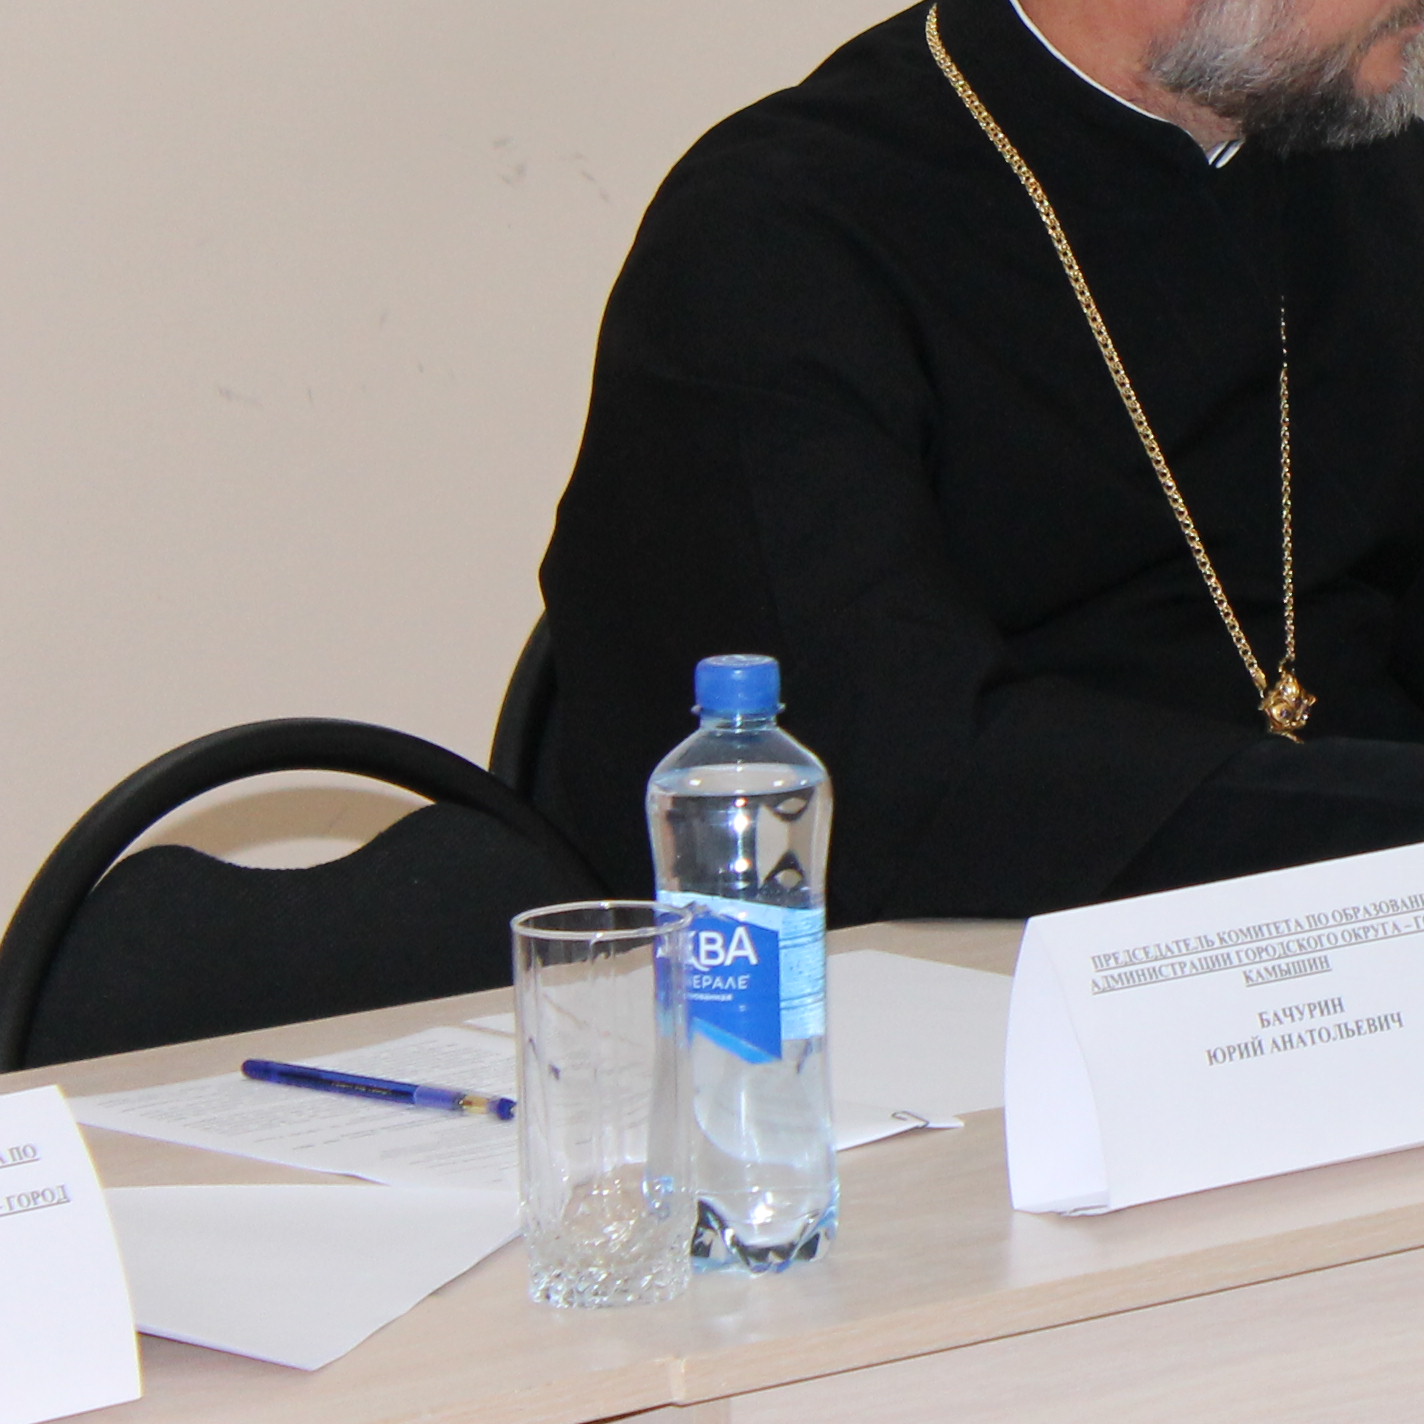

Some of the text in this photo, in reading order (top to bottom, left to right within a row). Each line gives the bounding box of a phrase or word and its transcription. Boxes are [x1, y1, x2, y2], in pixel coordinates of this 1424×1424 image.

[1090, 952, 1234, 993] АДМИНИСТРАЦИИ
[1236, 932, 1339, 965] ГОРОДСКОГО
[1341, 921, 1401, 945] ОКРУГА
[1091, 934, 1215, 971] ПРЕДСЕДАТЕЛЬ
[1217, 917, 1305, 947] КОМИТЕТА
[1306, 913, 1330, 930] ПО
[1243, 955, 1331, 986] КАМЫШИН
[1257, 997, 1346, 1029] БАЧУРИН
[1206, 1012, 1403, 1066] ЮРИЙ АНАТОЛЬЕВИЧ
[9, 1144, 38, 1163] ПО
[6, 1184, 70, 1212] ГОРОД
